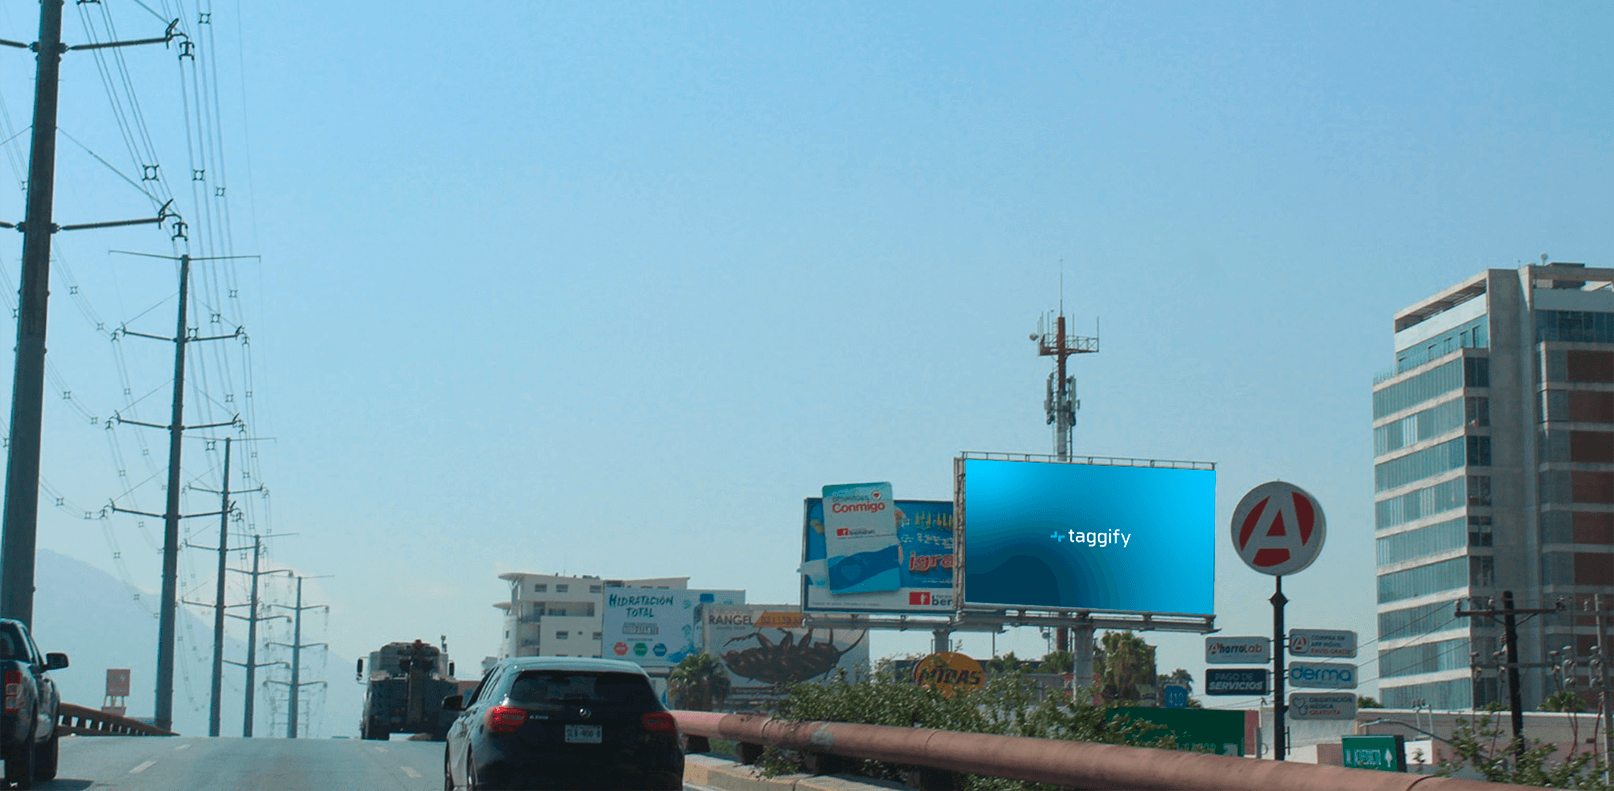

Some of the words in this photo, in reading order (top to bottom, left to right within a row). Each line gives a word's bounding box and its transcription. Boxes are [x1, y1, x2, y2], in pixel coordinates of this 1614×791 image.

[832, 502, 886, 514] Conmigo
[1067, 528, 1132, 548] taggify
[608, 594, 674, 608] HIDRATACIÓN
[626, 607, 655, 618] TOTAL
[708, 614, 754, 625] RANGEL
[1214, 673, 1240, 681] PAGO
[1241, 673, 1254, 681] DE
[1290, 665, 1352, 682] derma
[1208, 681, 1265, 691] SERVICIOS
